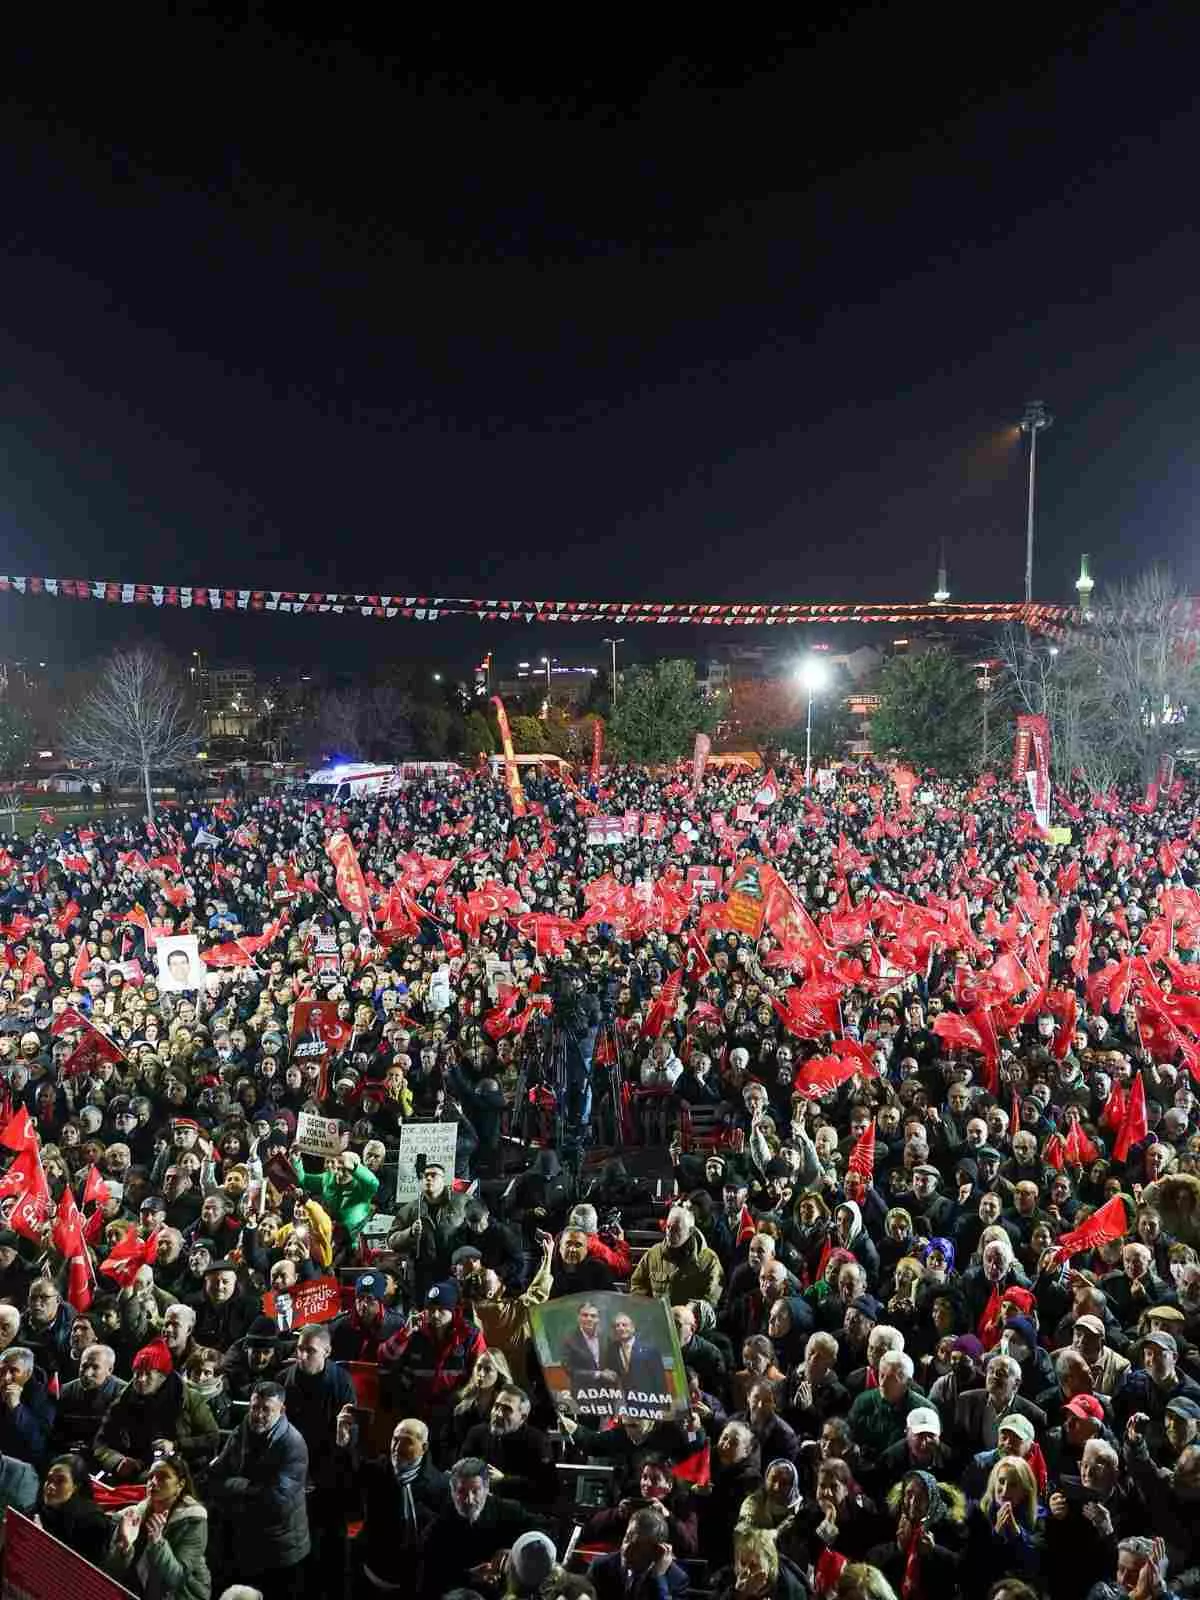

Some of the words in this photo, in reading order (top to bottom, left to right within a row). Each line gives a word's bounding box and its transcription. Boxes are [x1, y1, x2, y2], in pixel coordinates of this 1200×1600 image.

[577, 1388, 623, 1400] ADAM
[627, 1390, 673, 1404] ADAM
[618, 1406, 665, 1420] ADAM
